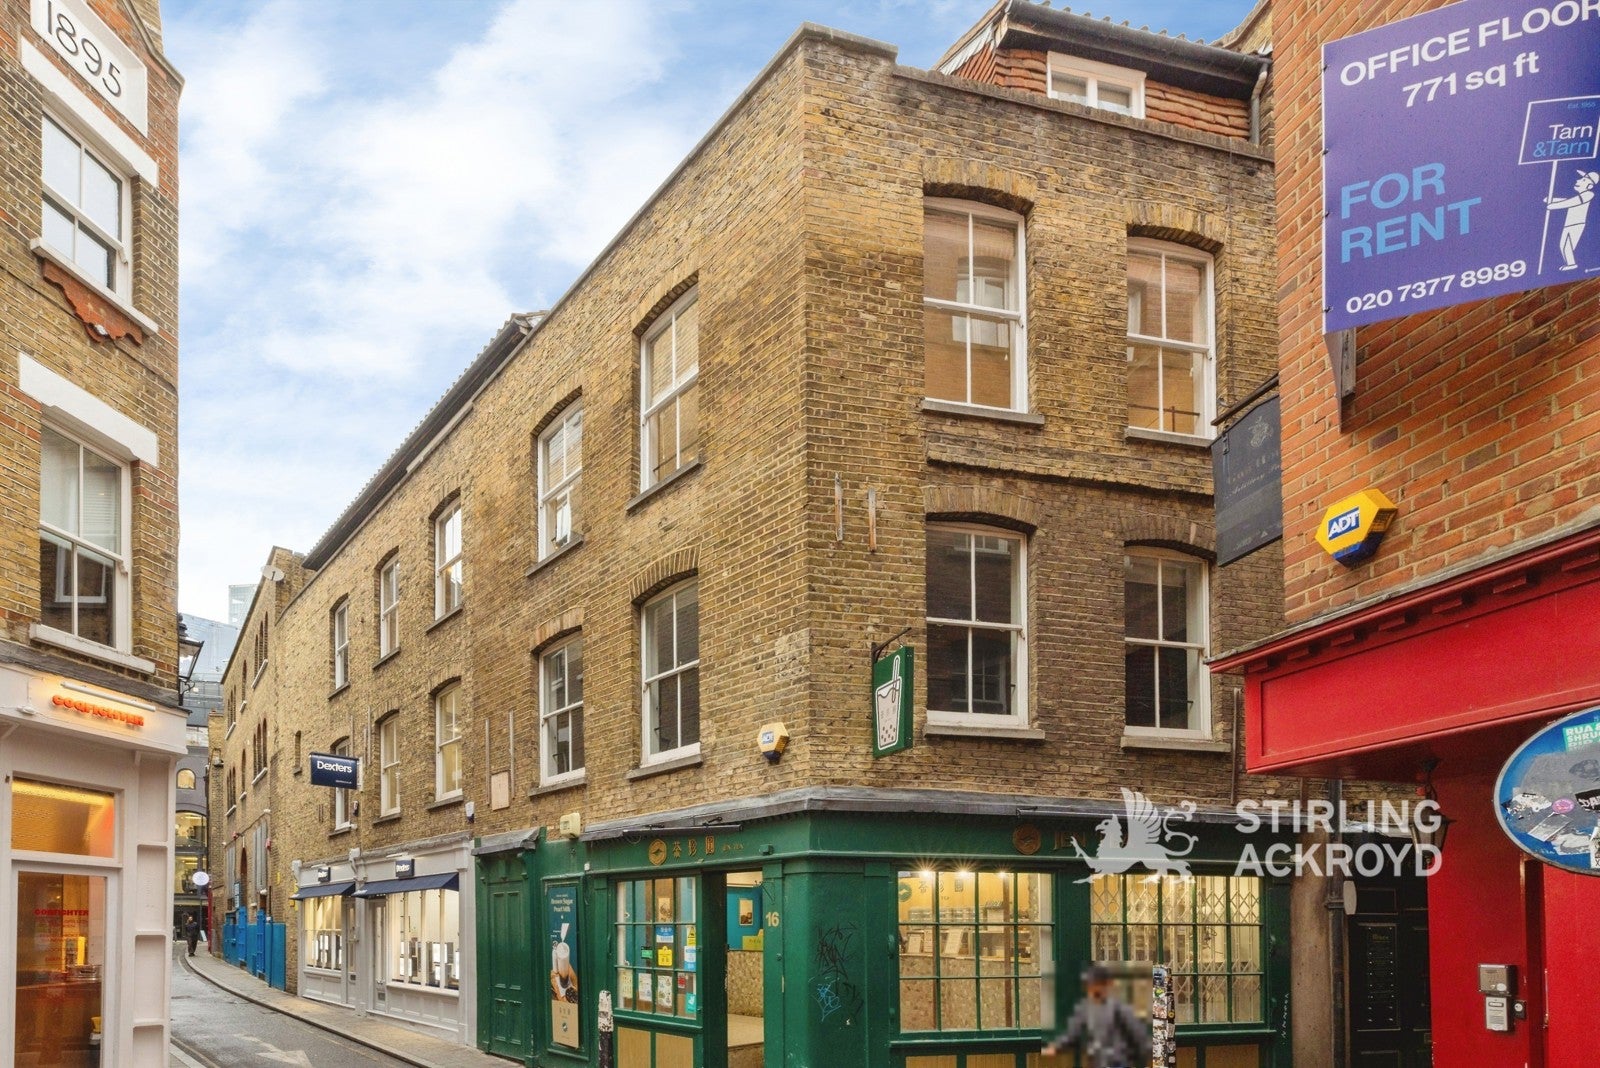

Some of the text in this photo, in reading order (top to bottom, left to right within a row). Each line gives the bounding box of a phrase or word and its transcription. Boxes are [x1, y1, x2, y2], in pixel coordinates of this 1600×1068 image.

[48, 0, 122, 97] 1895
[1340, 28, 1470, 86] OFFICE
[1402, 51, 1540, 108] 771 sq ft
[1533, 140, 1590, 157] &Tarn
[1549, 124, 1593, 140] Tarn
[1341, 162, 1446, 220] FOR
[1341, 197, 1482, 264] RENT
[1346, 259, 1526, 314] 020 7377 8989
[1328, 510, 1360, 538] ADT
[316, 760, 353, 773] Dexters
[765, 911, 780, 927] 16
